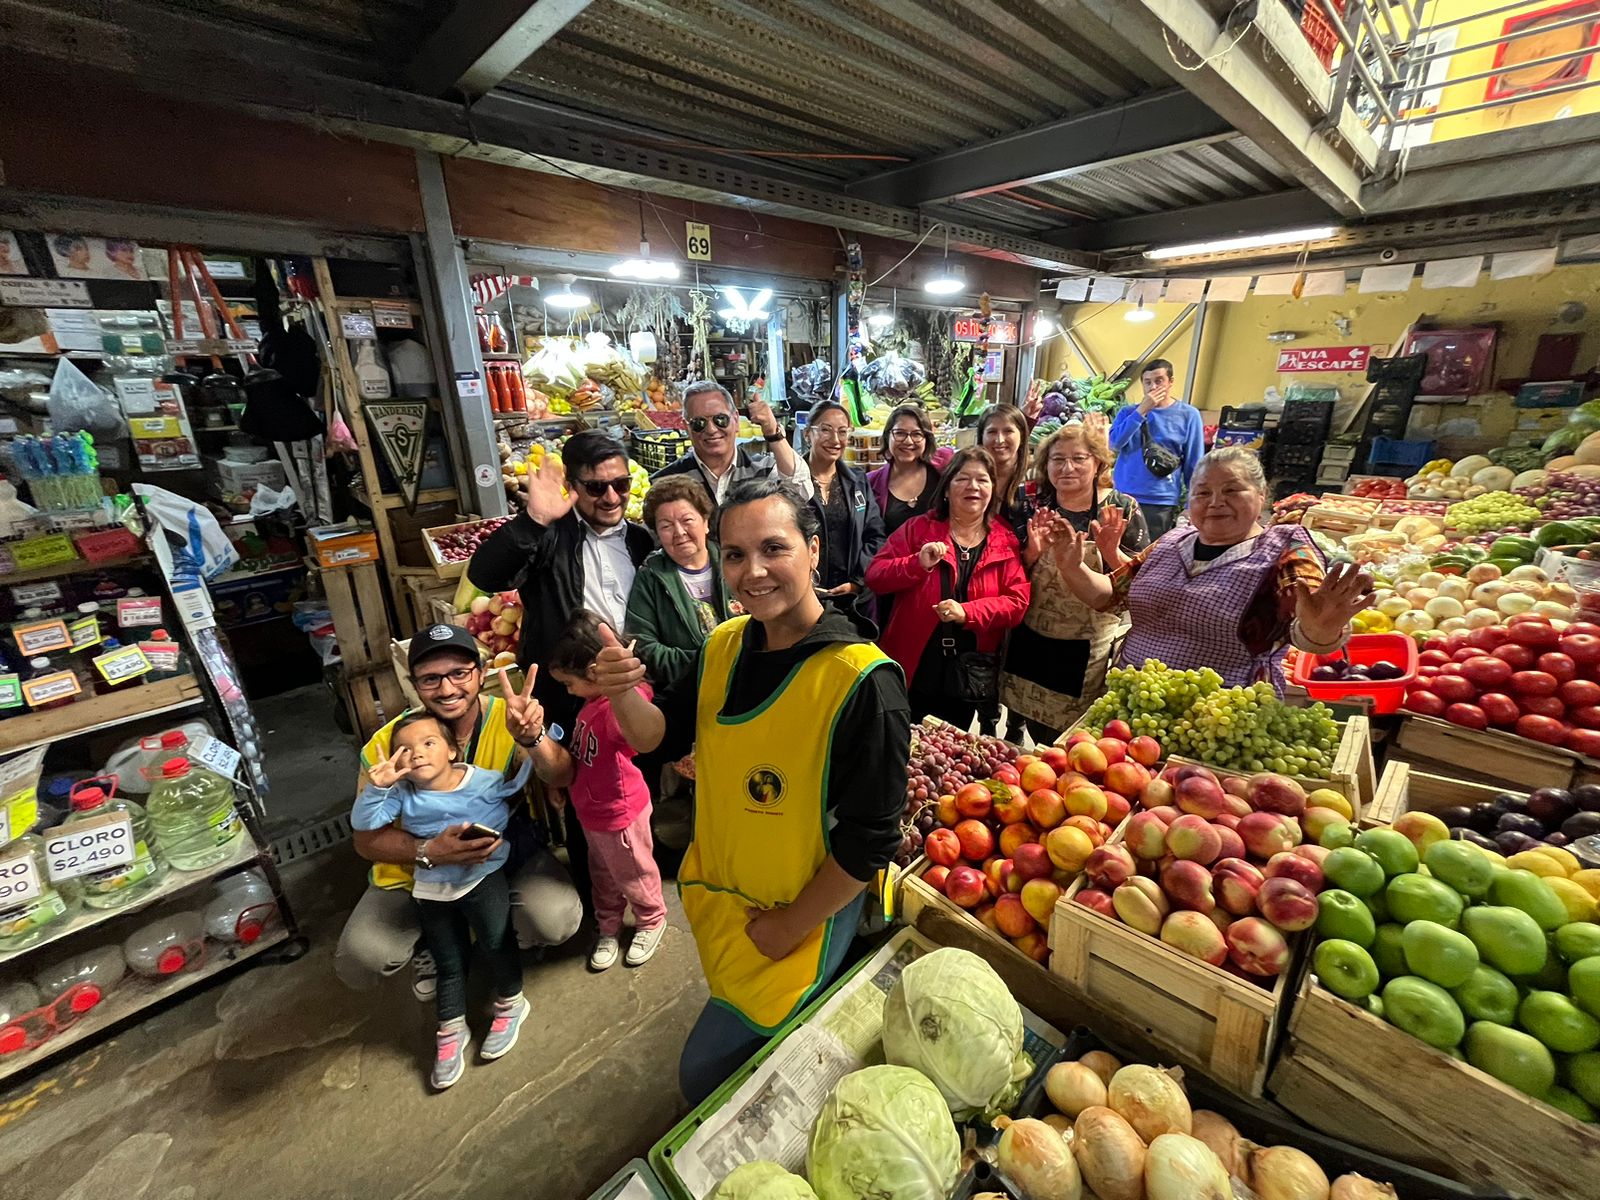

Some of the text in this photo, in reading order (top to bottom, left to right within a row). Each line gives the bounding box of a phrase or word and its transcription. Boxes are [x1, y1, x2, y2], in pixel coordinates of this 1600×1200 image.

[688, 236, 709, 255] 69
[1301, 350, 1328, 360] VIA
[1296, 360, 1363, 370] ESCAPE
[368, 405, 424, 420] WANDERERS
[108, 660, 144, 676] $1.490
[48, 827, 126, 855] CLORO
[53, 844, 125, 871] $2.490
